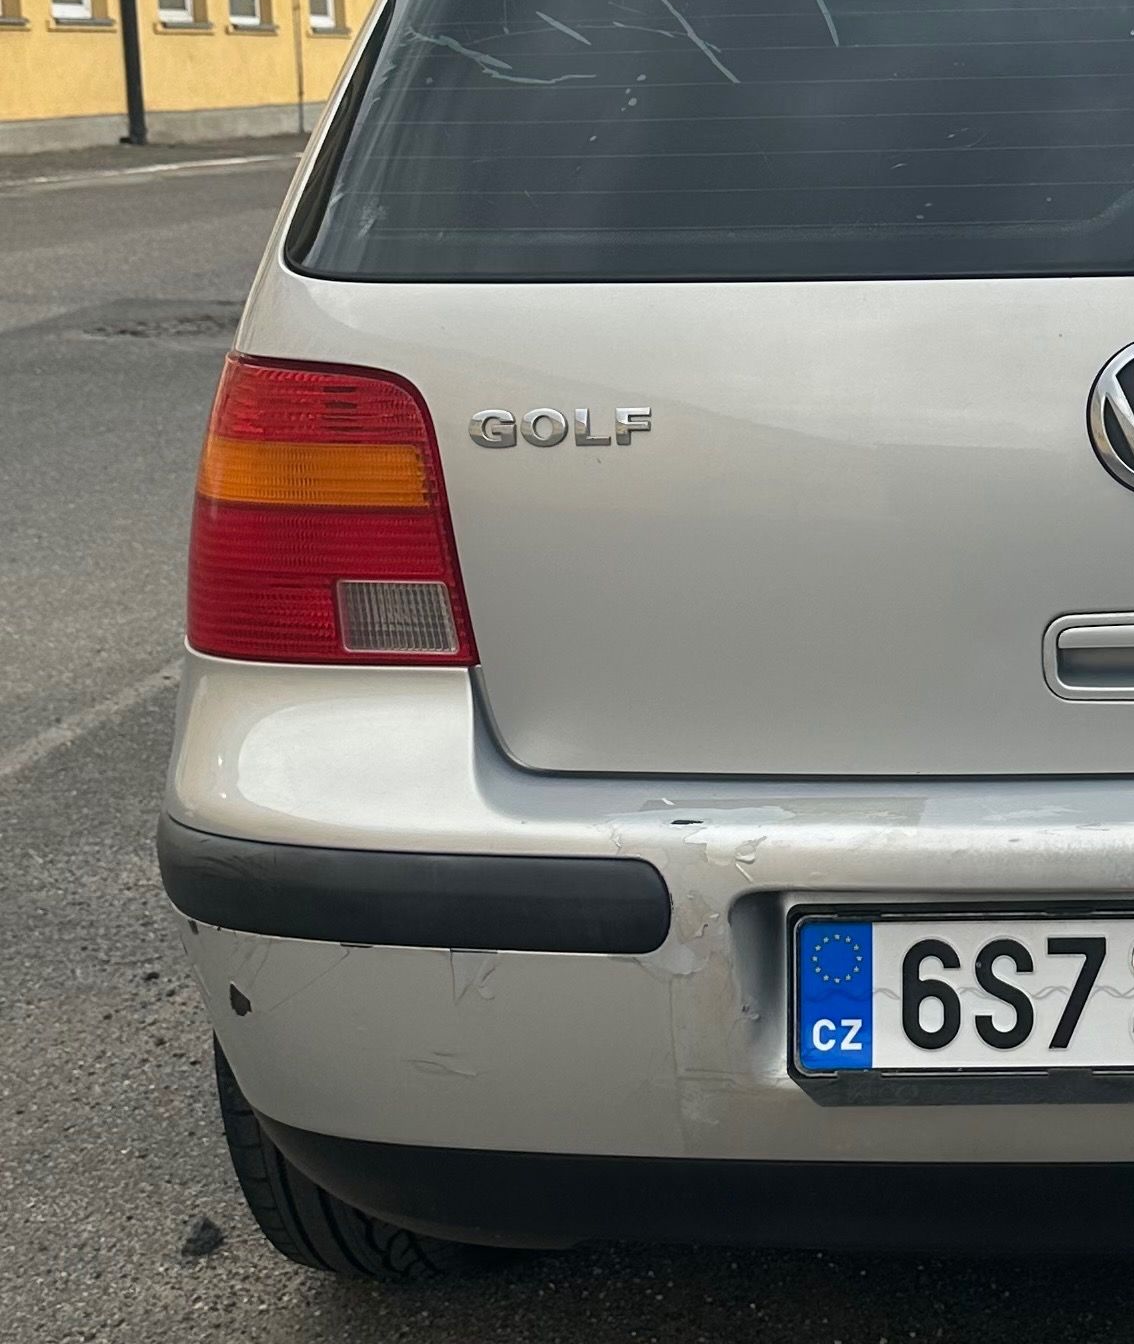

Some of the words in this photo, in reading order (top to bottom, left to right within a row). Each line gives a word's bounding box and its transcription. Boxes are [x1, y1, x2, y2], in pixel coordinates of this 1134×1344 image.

[469, 407, 652, 448] GOLF
[902, 937, 1107, 1050] 6S7
[812, 1019, 863, 1052] CZ
